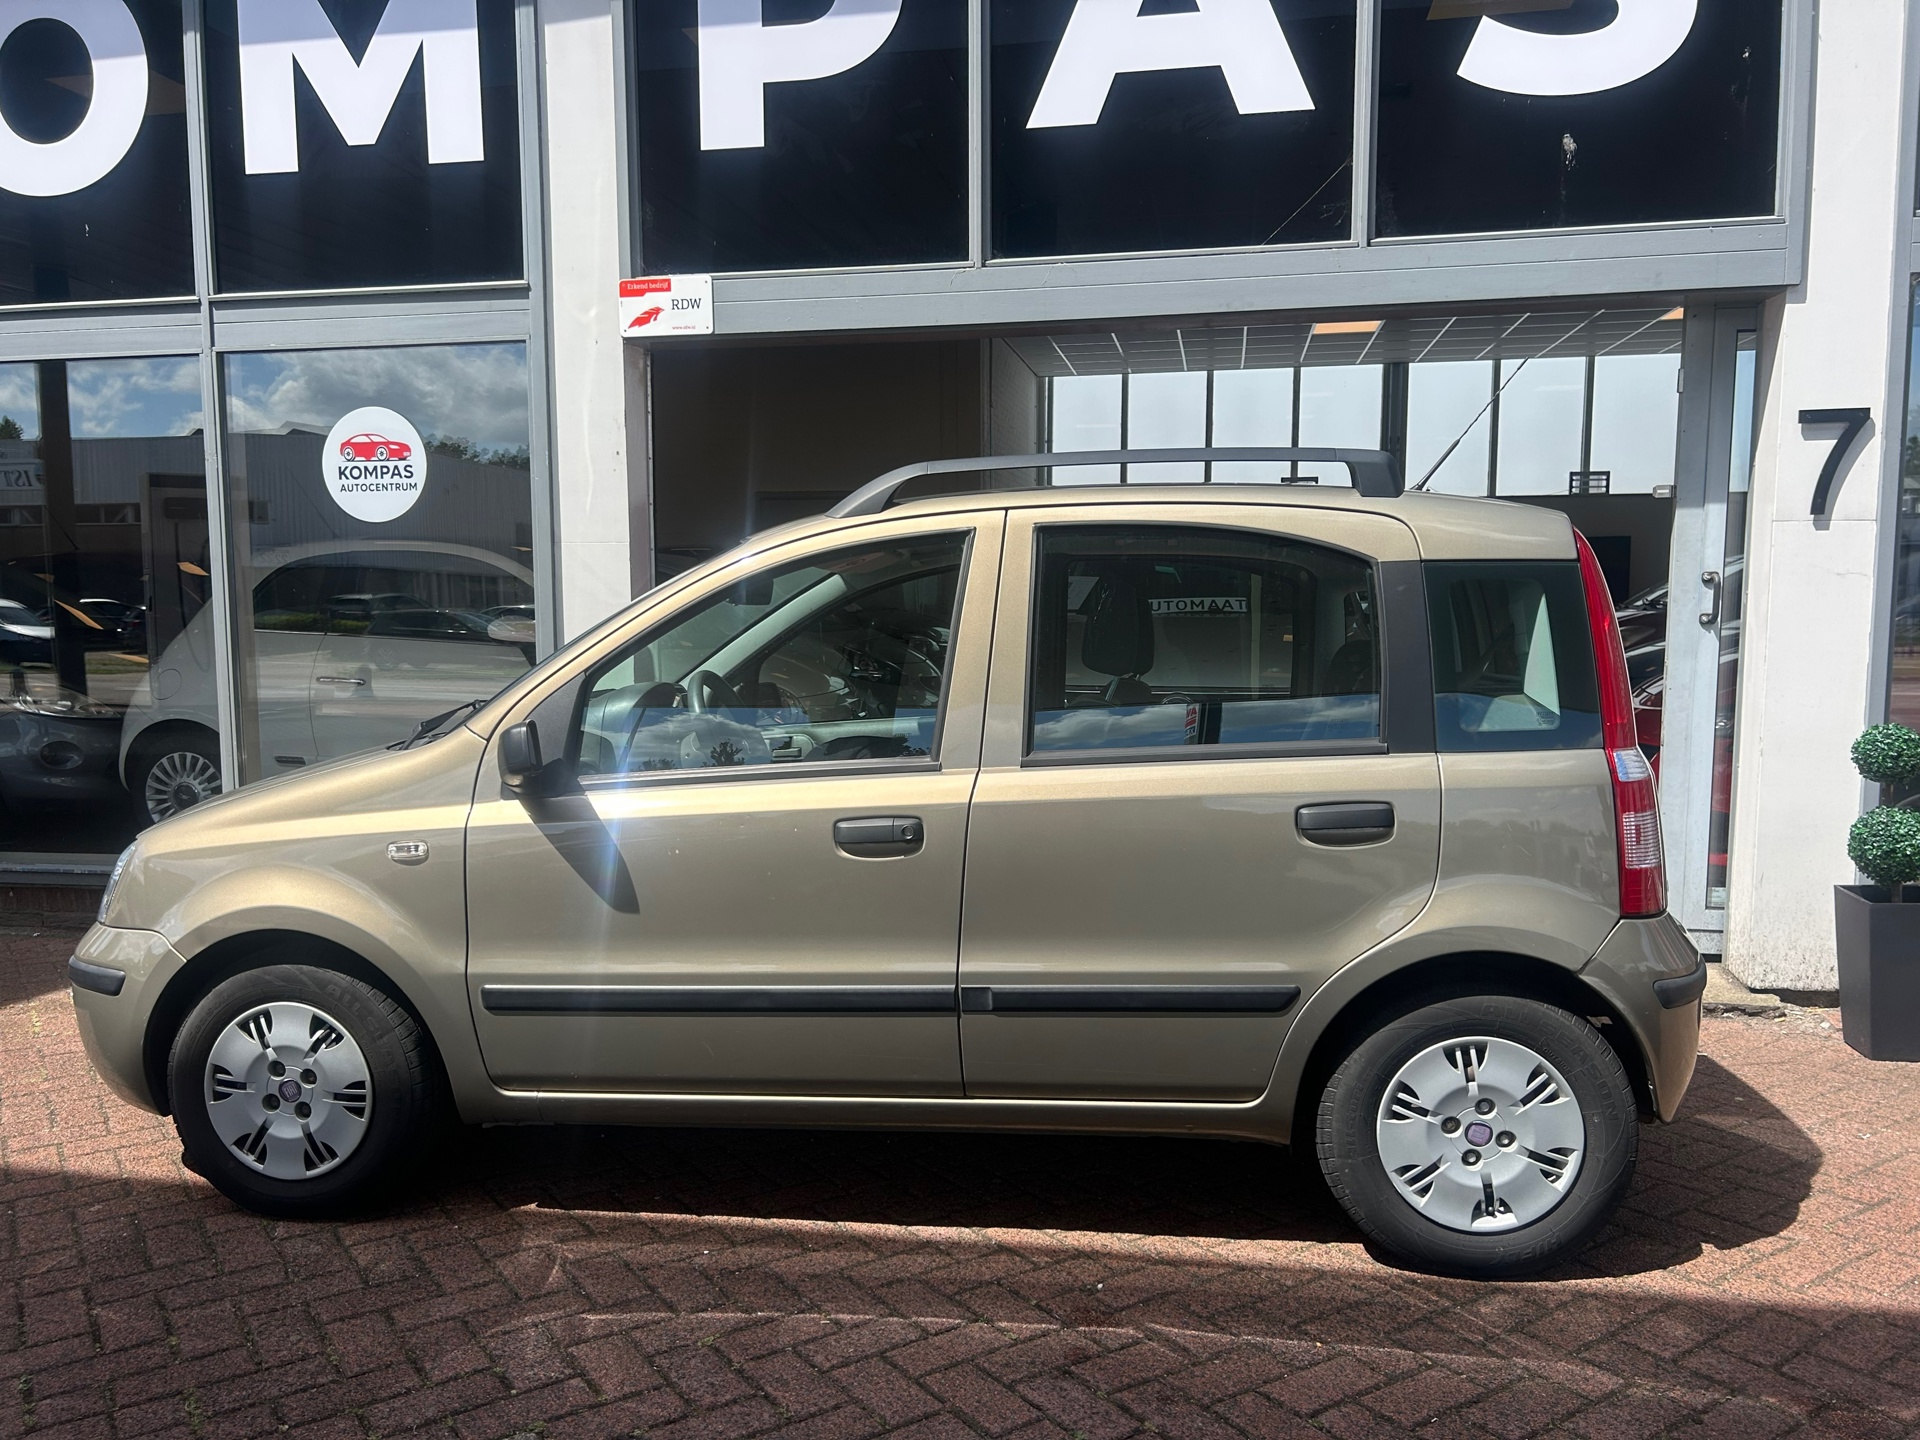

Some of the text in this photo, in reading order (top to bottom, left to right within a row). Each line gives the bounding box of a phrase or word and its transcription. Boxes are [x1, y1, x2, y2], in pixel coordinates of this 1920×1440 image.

[649, 282, 669, 290] bedrijf
[671, 298, 702, 311] RDW
[1798, 406, 1871, 516] 7
[338, 464, 414, 480] KOMPAS
[340, 482, 418, 493] AUTOCENTRUM
[1151, 599, 1247, 612] UTOMAAT
